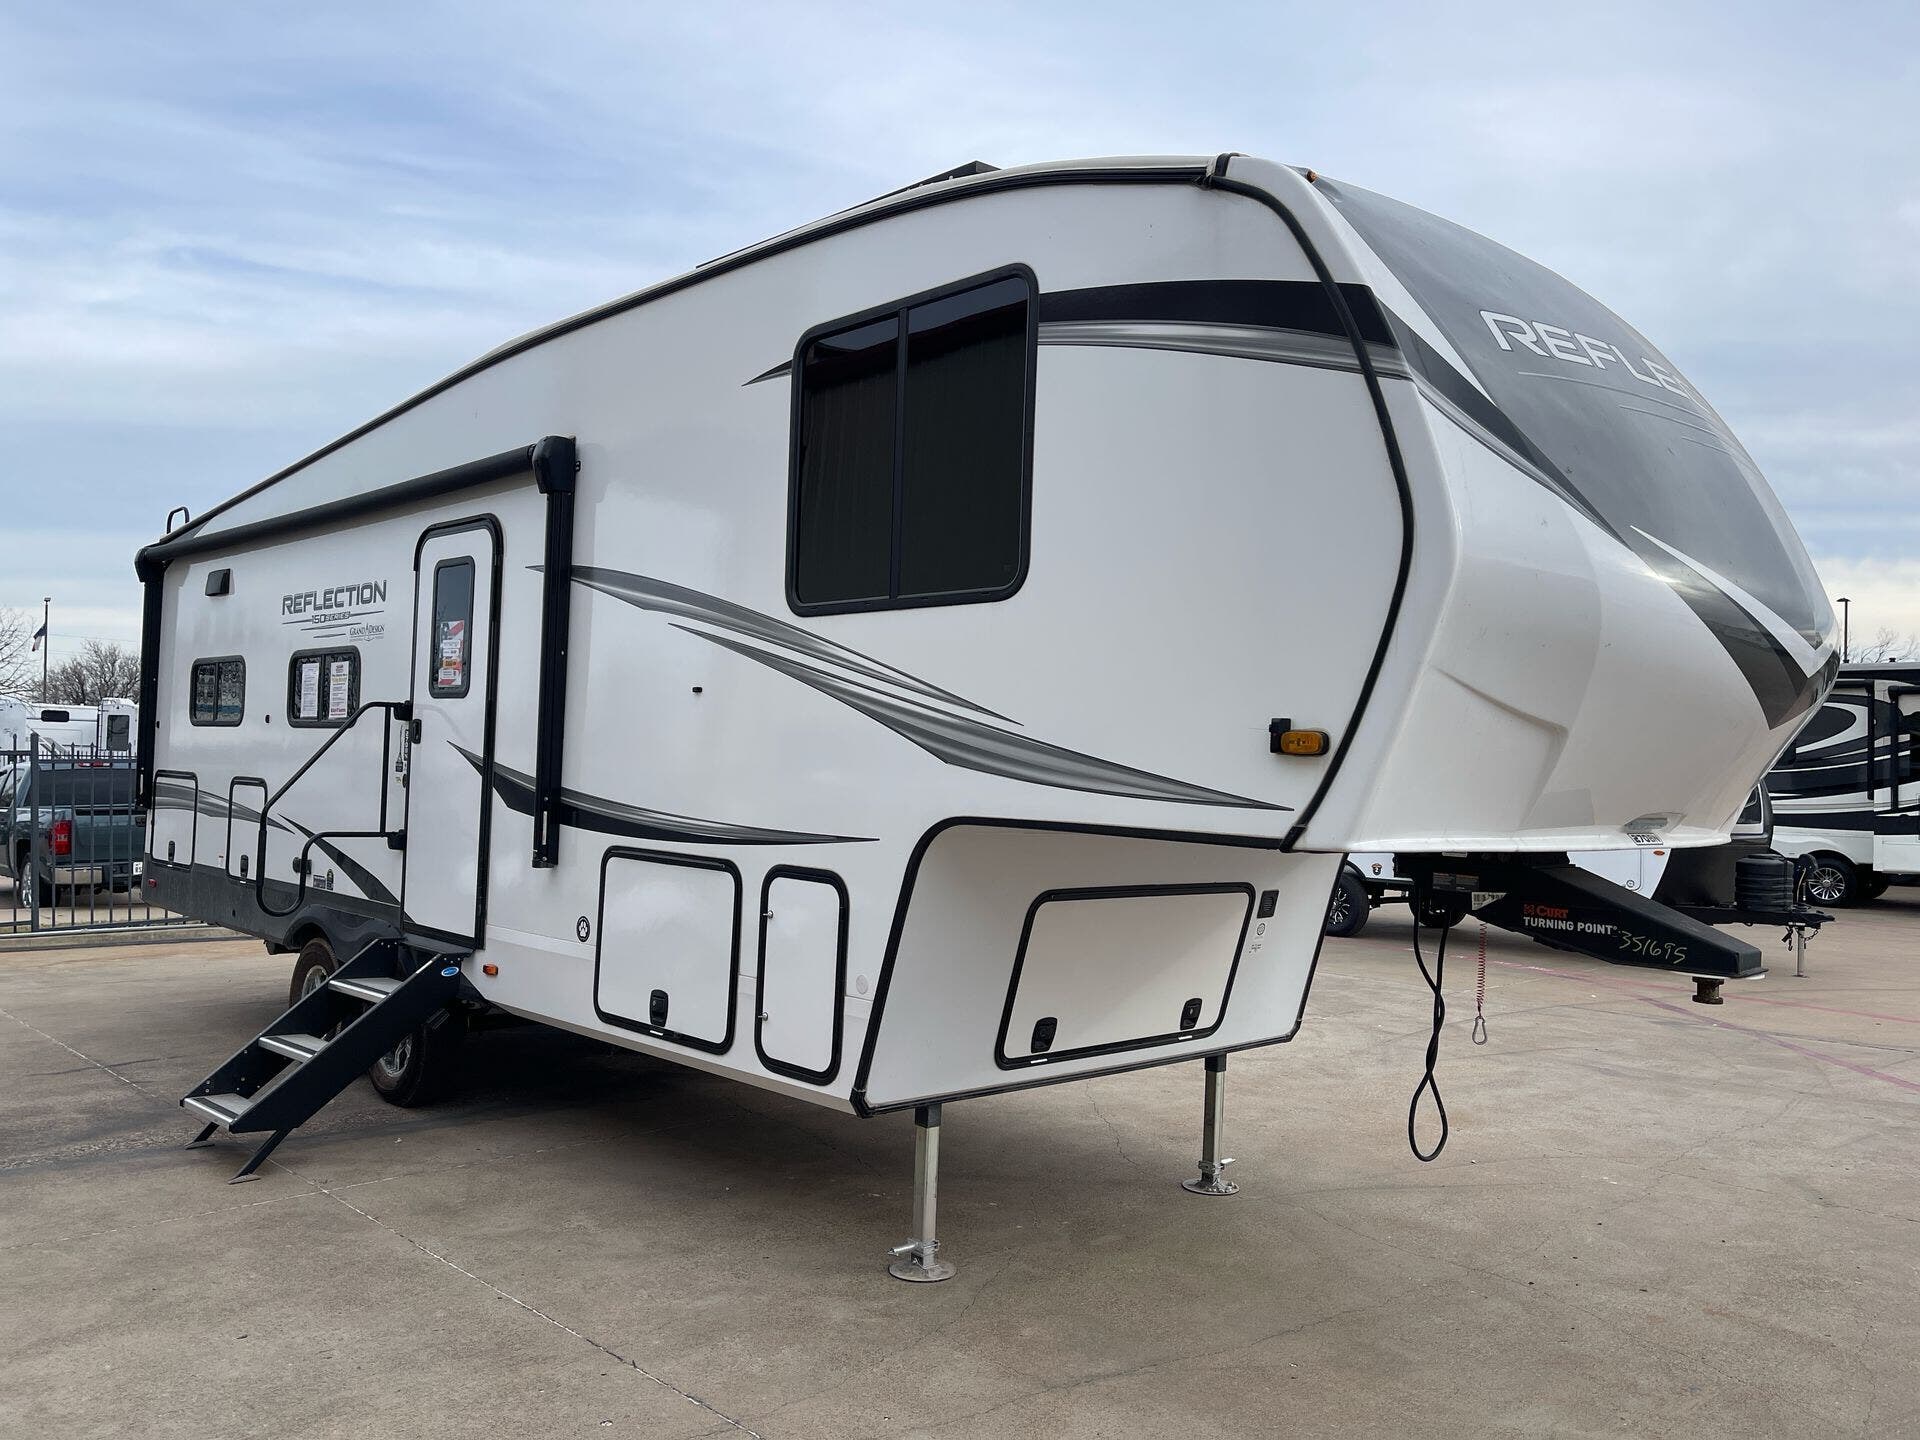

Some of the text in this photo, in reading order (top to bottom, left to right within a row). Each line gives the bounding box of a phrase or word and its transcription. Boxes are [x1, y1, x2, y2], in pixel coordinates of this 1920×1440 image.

[282, 580, 387, 615] REFLECTION
[1536, 906, 1569, 919] CURT
[1523, 916, 1574, 931] TURNING
